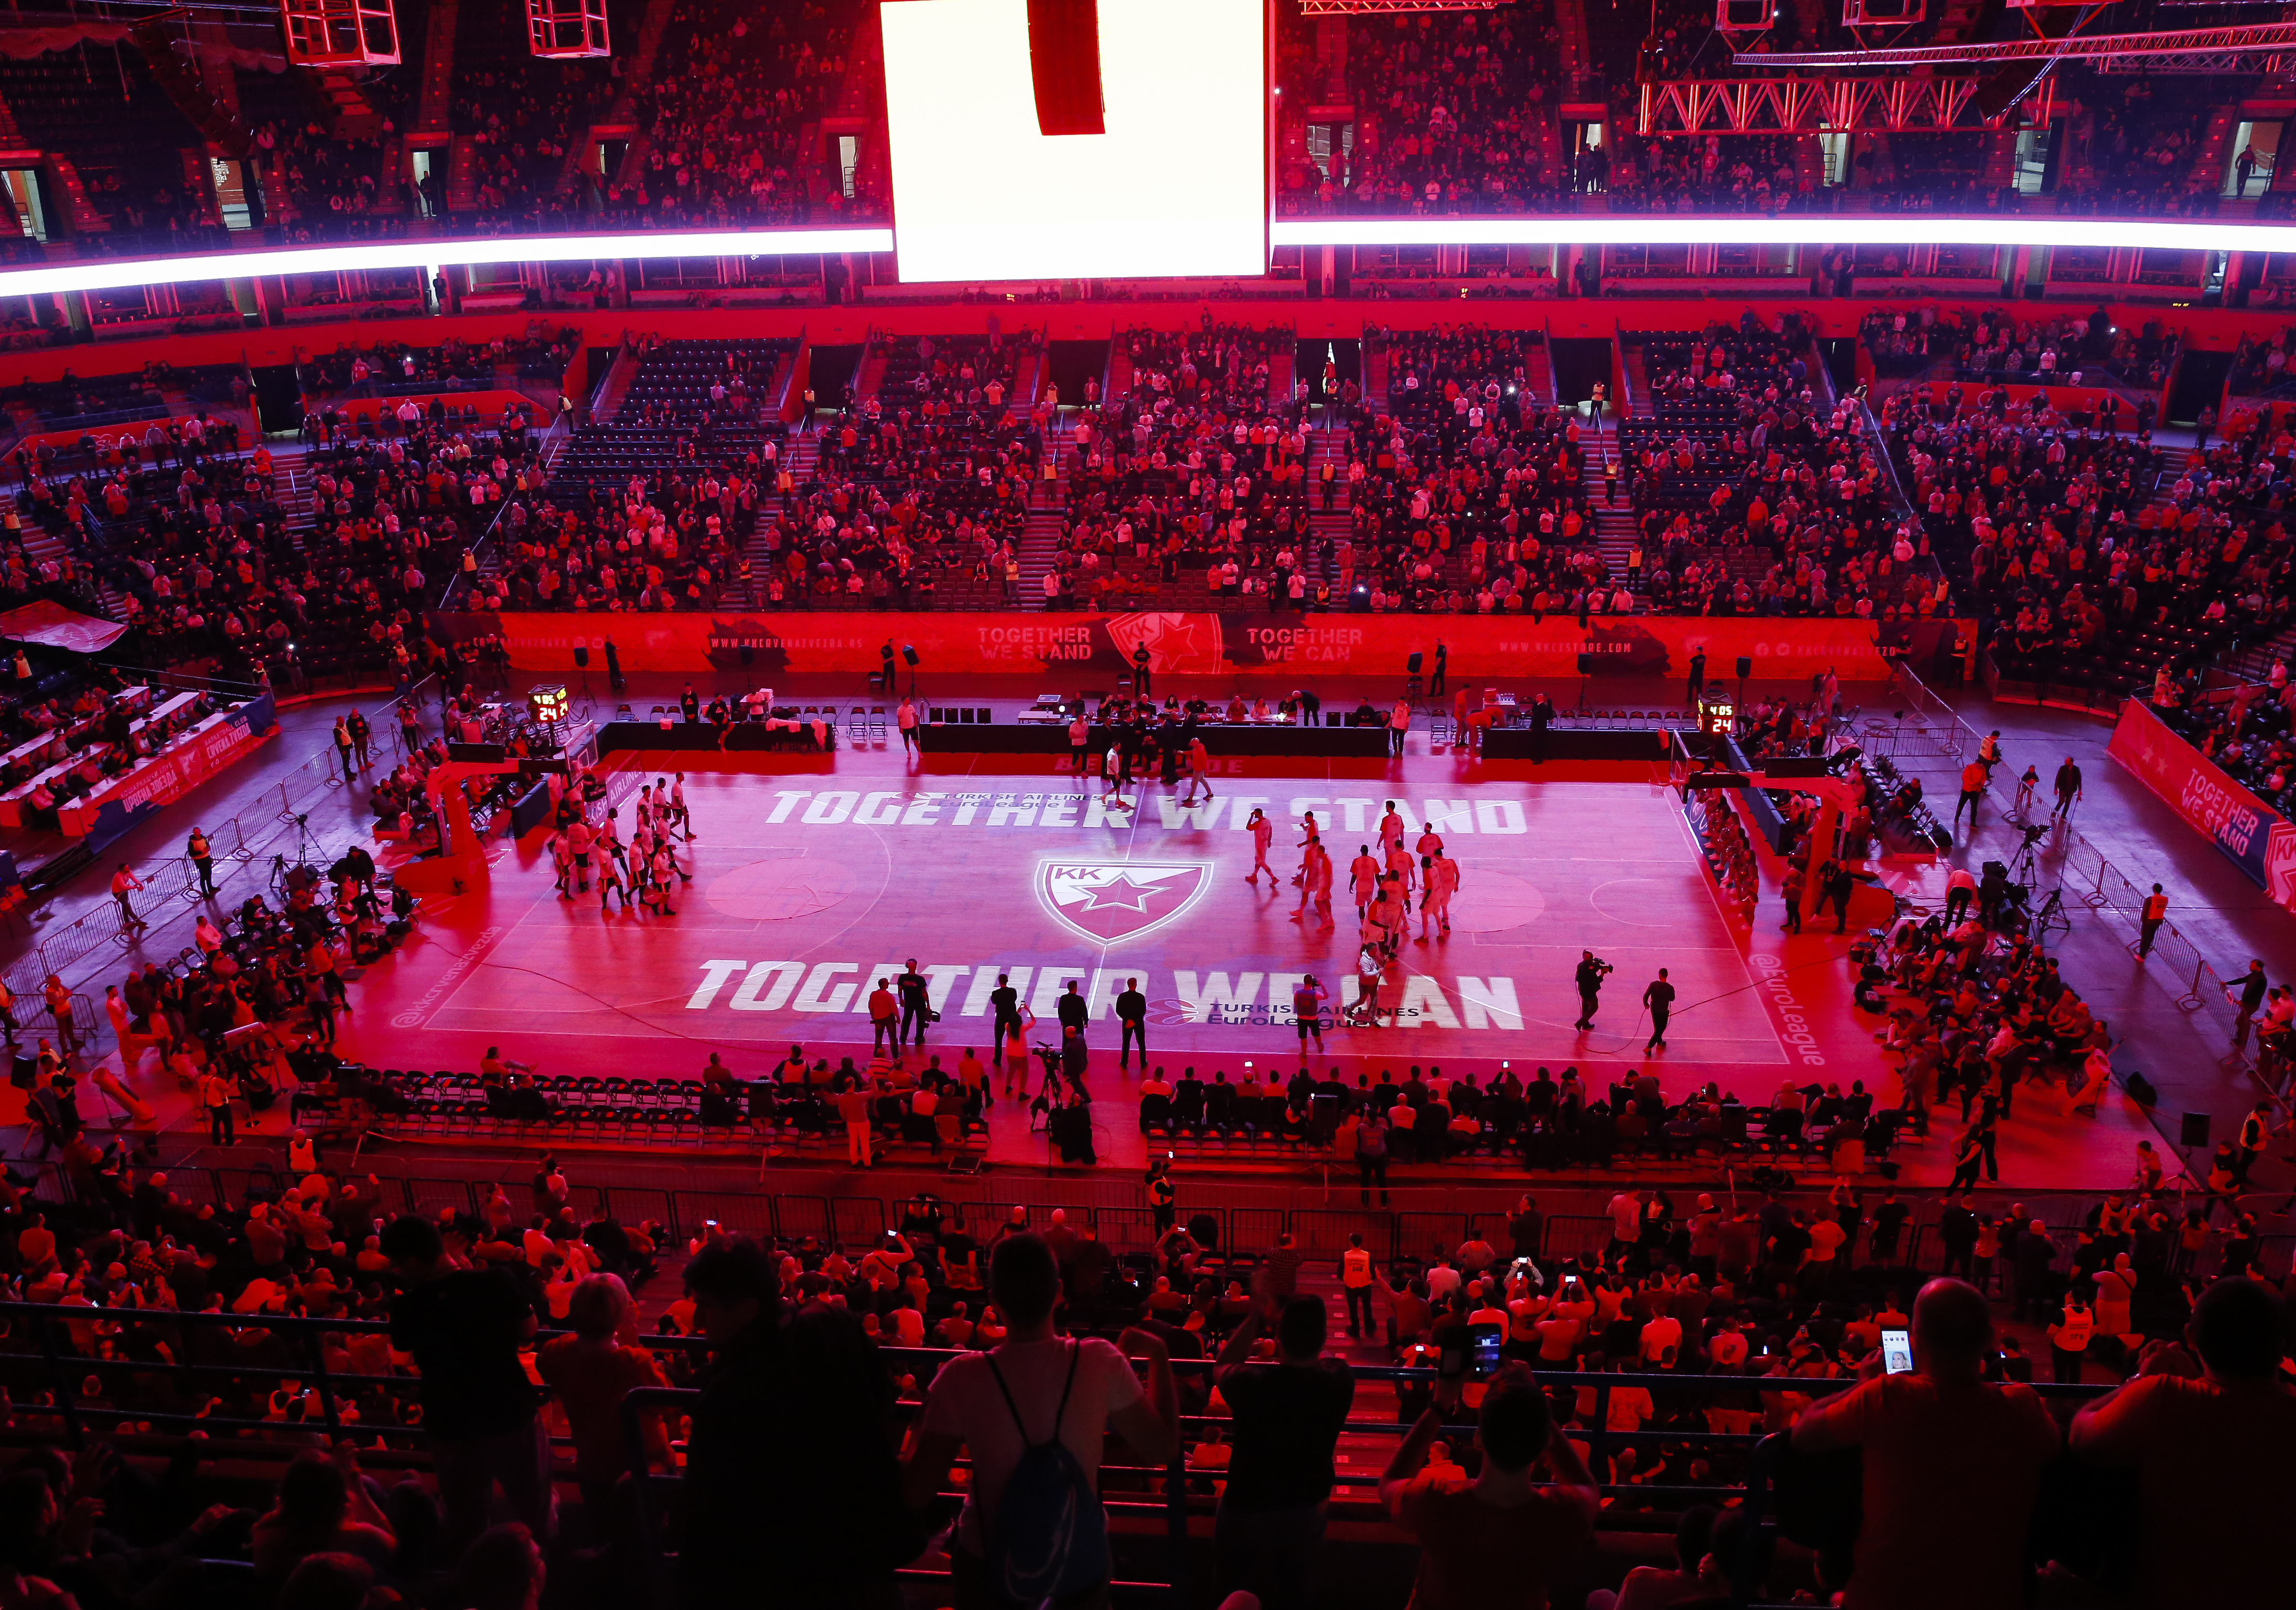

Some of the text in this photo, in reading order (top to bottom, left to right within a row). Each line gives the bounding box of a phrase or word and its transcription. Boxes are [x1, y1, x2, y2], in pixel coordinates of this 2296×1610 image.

[977, 627, 1090, 643] TOGETHER
[1122, 618, 1152, 642] KK
[1246, 628, 1362, 644] TOGETHER
[979, 645, 1092, 660] WE STAND
[1261, 645, 1350, 661] WE CAN
[539, 707, 558, 721] 24
[1713, 719, 1732, 732] 24
[609, 761, 642, 804] AIRLINES
[938, 800, 1060, 810] EuroLeague
[2186, 767, 2259, 837] TOGETHER
[765, 790, 1529, 834] TOGETHER WE STAND
[2181, 788, 2249, 857] WE STAND
[1055, 868, 1102, 880] KK
[685, 959, 1149, 1021] TOGETHER
[1174, 970, 1305, 1024] WE
[1210, 1003, 1297, 1013] TURKIS
[1748, 953, 1825, 1066] @EuroLeague
[1207, 1014, 1368, 1031] EuroLegue
